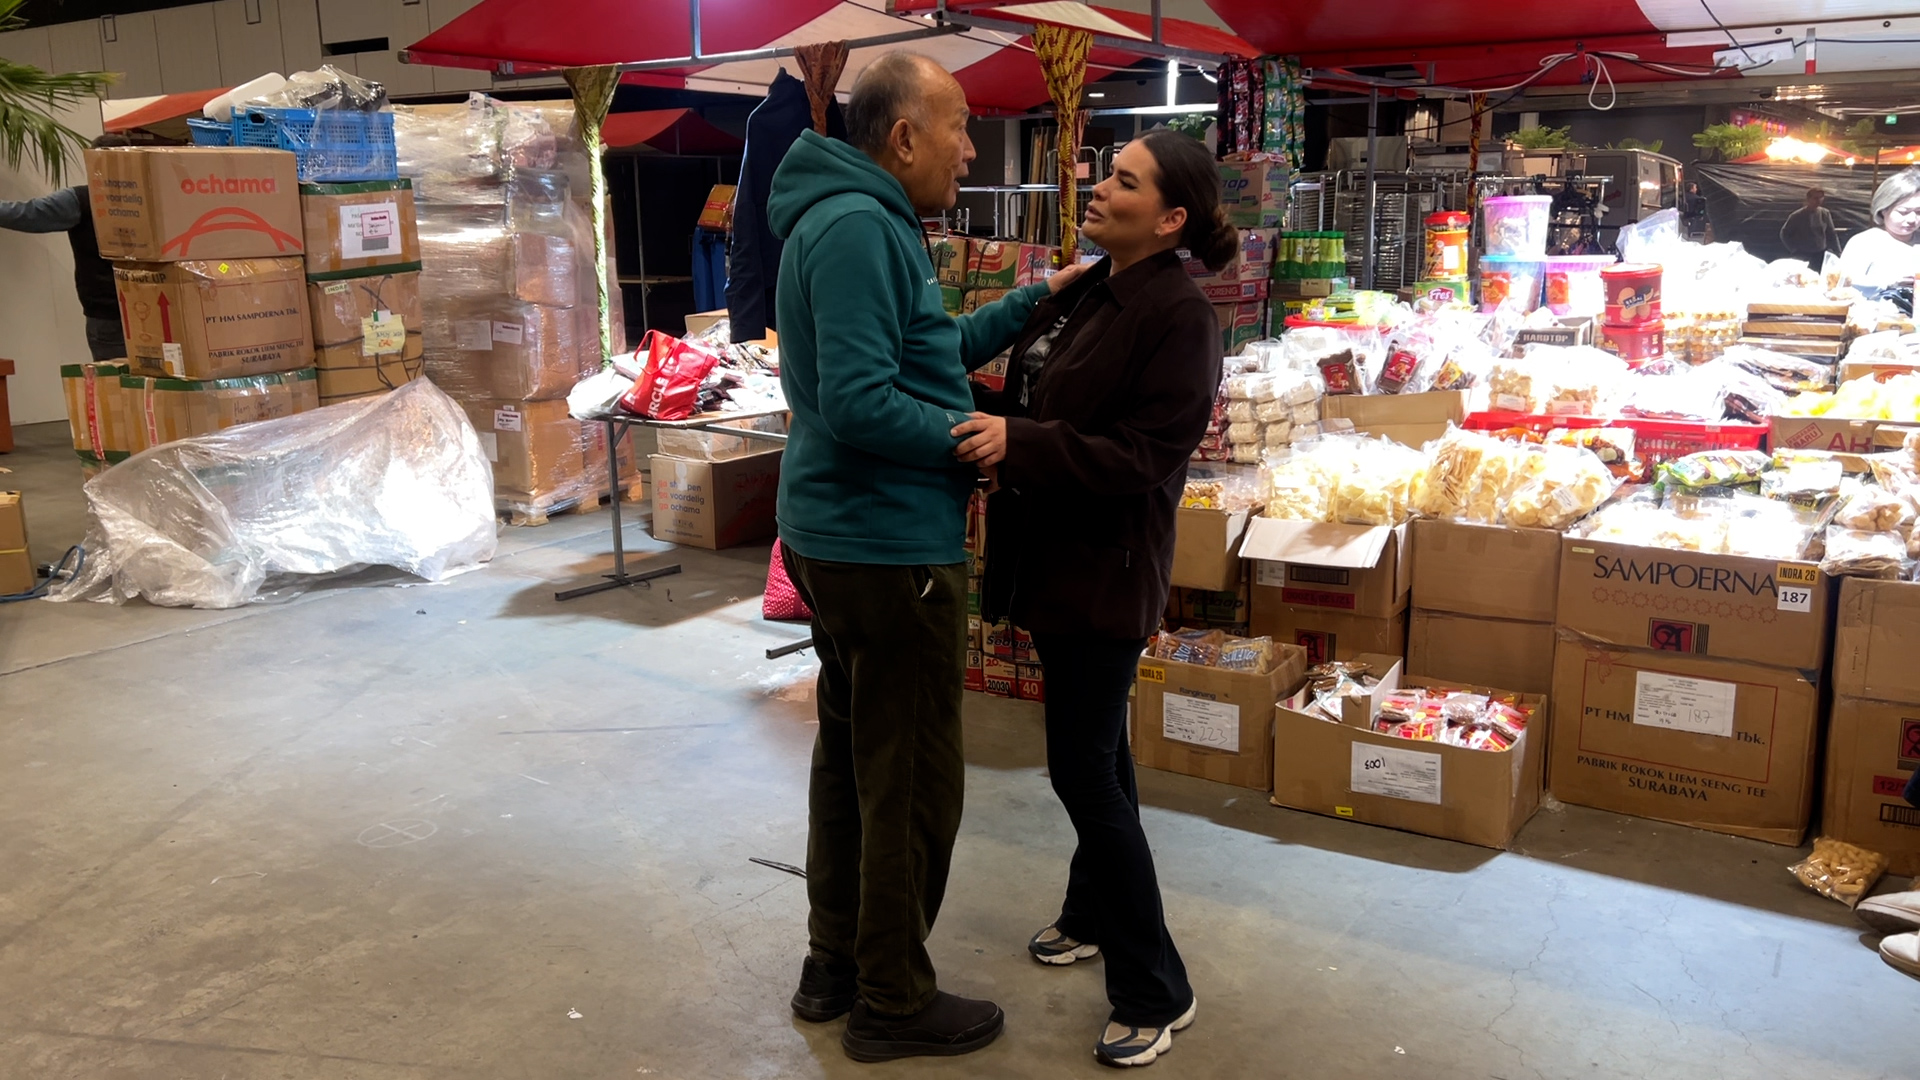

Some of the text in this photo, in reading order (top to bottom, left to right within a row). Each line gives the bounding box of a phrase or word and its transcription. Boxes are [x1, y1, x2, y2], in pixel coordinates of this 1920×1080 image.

[180, 173, 277, 195] ochama
[1205, 286, 1238, 296] GORENG
[205, 316, 217, 324] PT
[236, 311, 285, 322] SAMPOERNA
[1523, 334, 1569, 343] HARDTOP
[208, 350, 234, 359] PABRIK
[241, 352, 282, 365] SURABAYA
[670, 480, 702, 492] shpen
[670, 493, 705, 505] voordelig
[671, 504, 701, 514] ochama
[1593, 555, 1778, 598] SAMPOERNA
[1780, 567, 1816, 581] INDRA 26
[1781, 591, 1808, 604] 187
[987, 679, 1010, 692] 20030
[1023, 682, 1039, 695] 40
[1585, 706, 1631, 723] PT HM
[1688, 708, 1714, 725] 187
[1199, 726, 1228, 746] 223
[1736, 731, 1766, 745] Tbk.
[1577, 755, 1767, 798] PABRIK ROKOK LIEM SEENG TEE
[1628, 777, 1708, 801] SURABAYA
